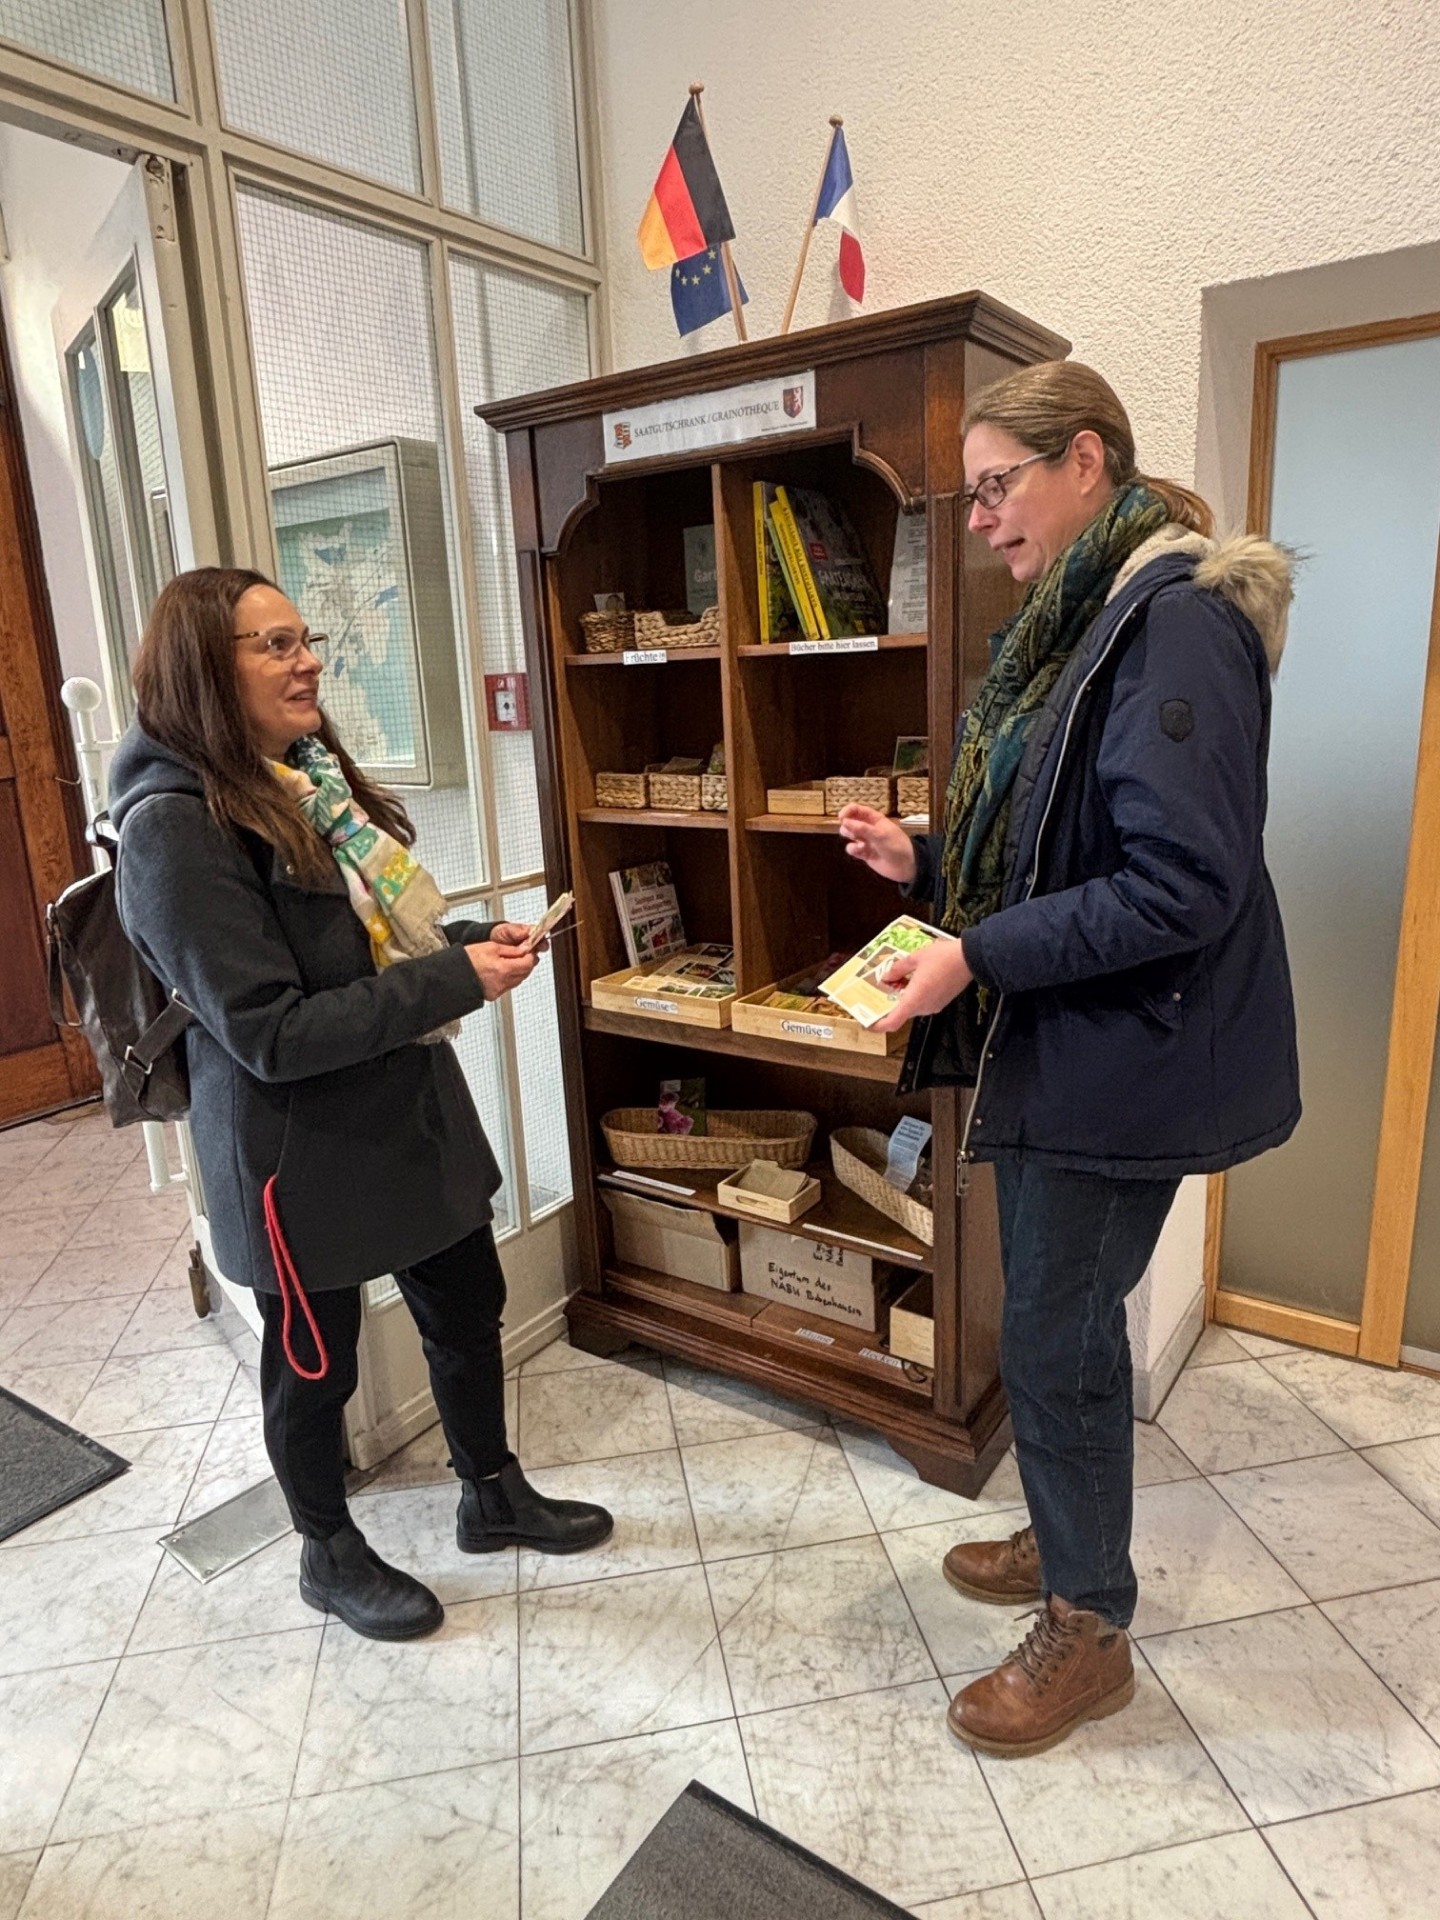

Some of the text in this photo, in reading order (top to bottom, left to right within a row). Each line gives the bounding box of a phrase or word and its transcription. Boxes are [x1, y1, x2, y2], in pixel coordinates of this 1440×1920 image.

[634, 414, 706, 438] SAATGUTSCHRANK
[634, 996, 670, 1011] Gemüse
[781, 1020, 822, 1037] Gemüse
[768, 1262, 831, 1291] Eigentum des
